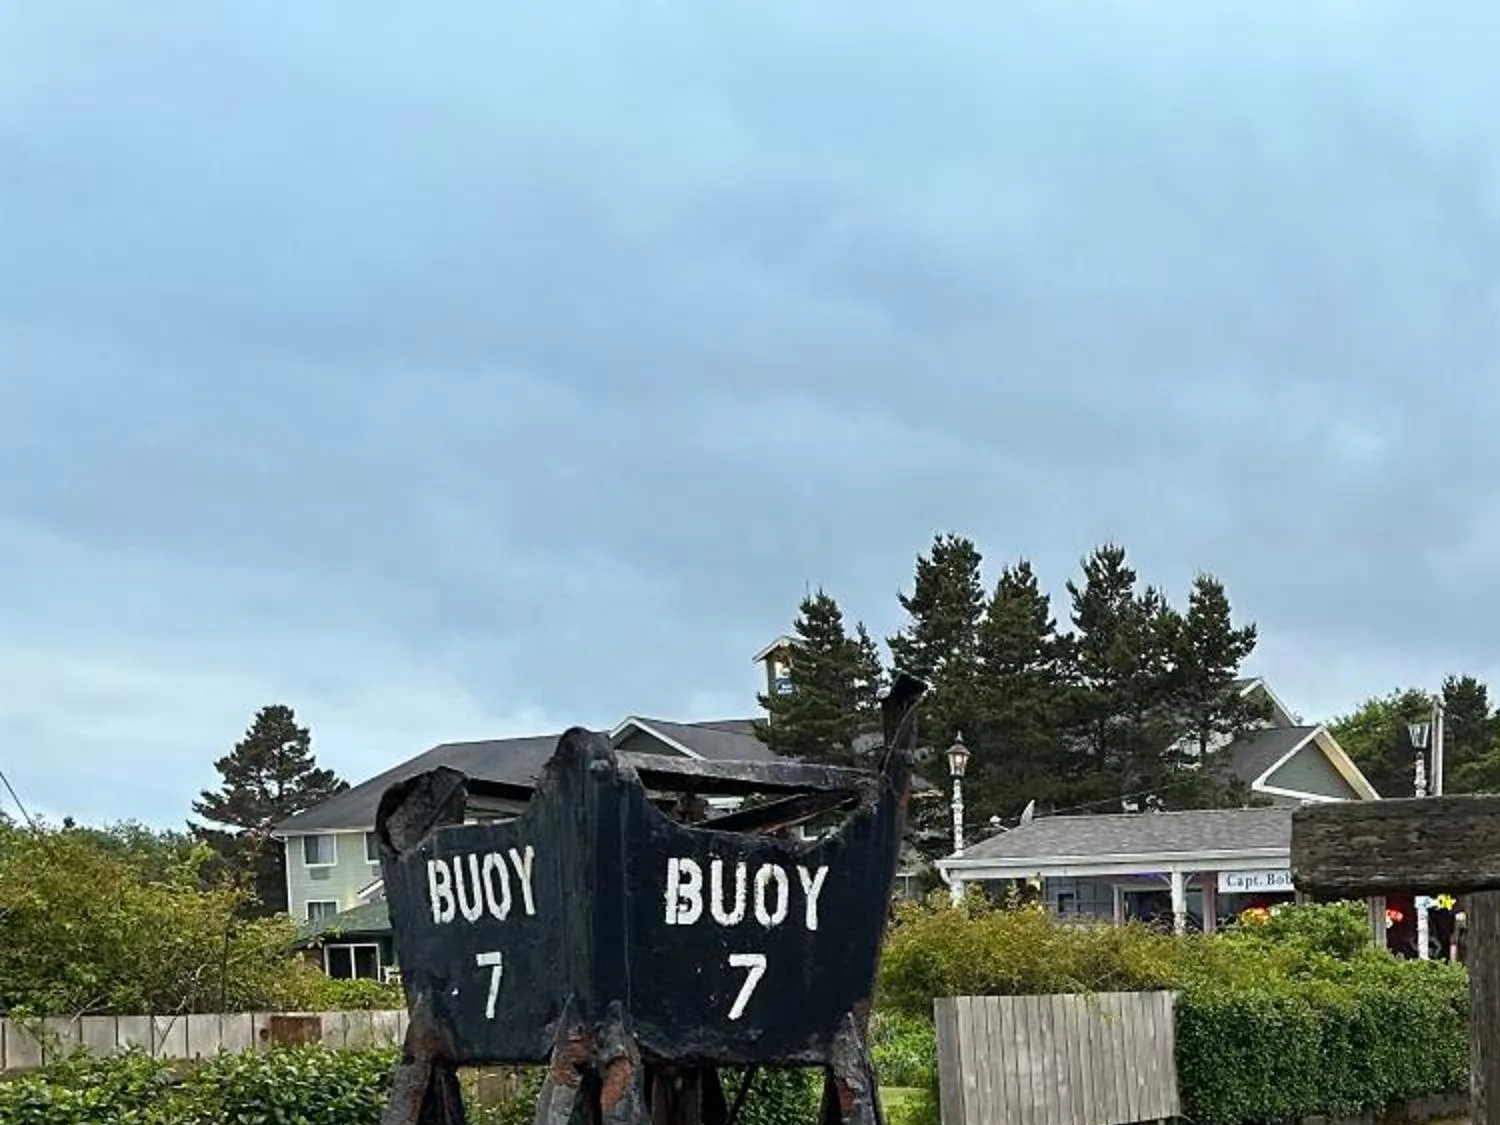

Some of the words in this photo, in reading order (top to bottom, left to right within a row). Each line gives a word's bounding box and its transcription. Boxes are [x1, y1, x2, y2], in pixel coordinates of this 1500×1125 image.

[428, 846, 536, 925] BUOY
[664, 857, 829, 931] BUOY
[1227, 873, 1263, 889] Capt.
[476, 952, 503, 1019] 7
[729, 954, 767, 1020] 7
